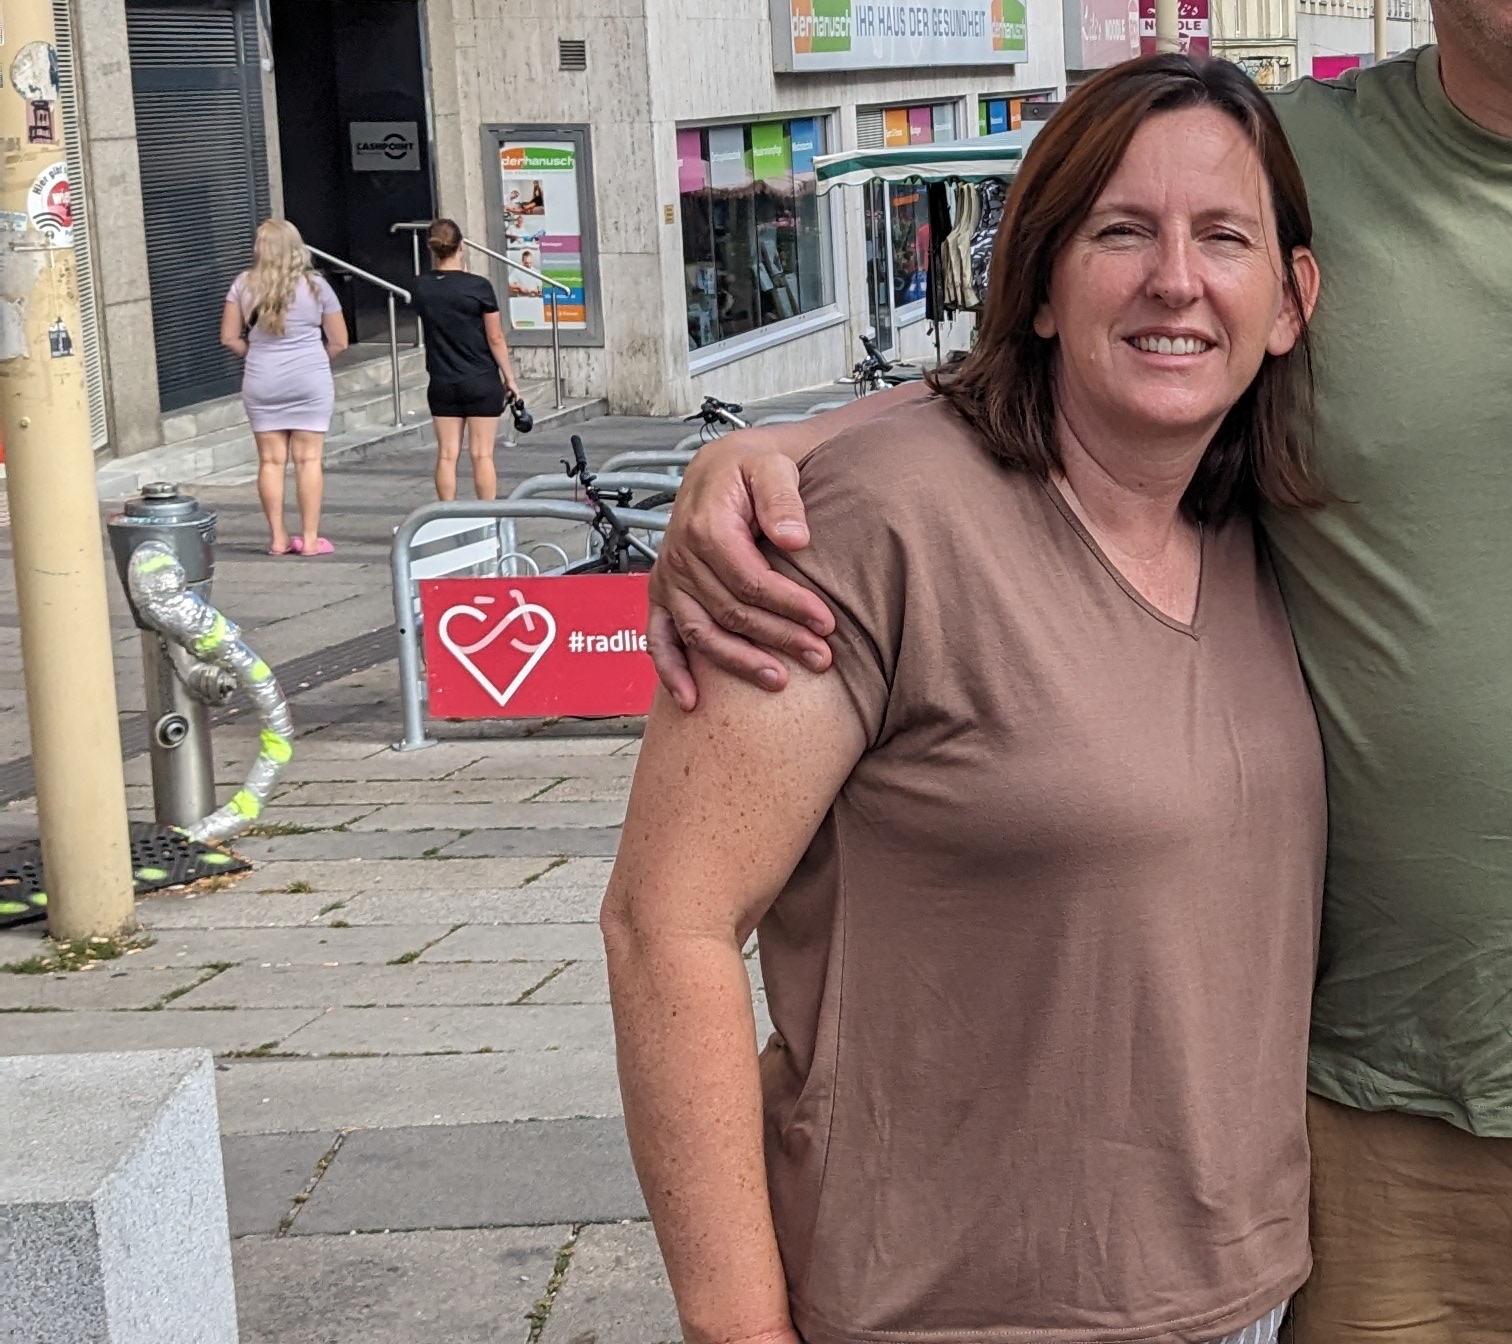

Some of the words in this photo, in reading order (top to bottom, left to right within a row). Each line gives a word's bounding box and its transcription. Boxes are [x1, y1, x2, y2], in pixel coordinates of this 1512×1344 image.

[791, 9, 852, 38] derhanusch
[855, 5, 875, 37] IHR
[878, 6, 906, 37] HAUS
[909, 7, 930, 37] DER
[932, 8, 986, 38] GESUNDHEIT
[1145, 20, 1202, 31] NDLE
[501, 155, 575, 167] derhanusch
